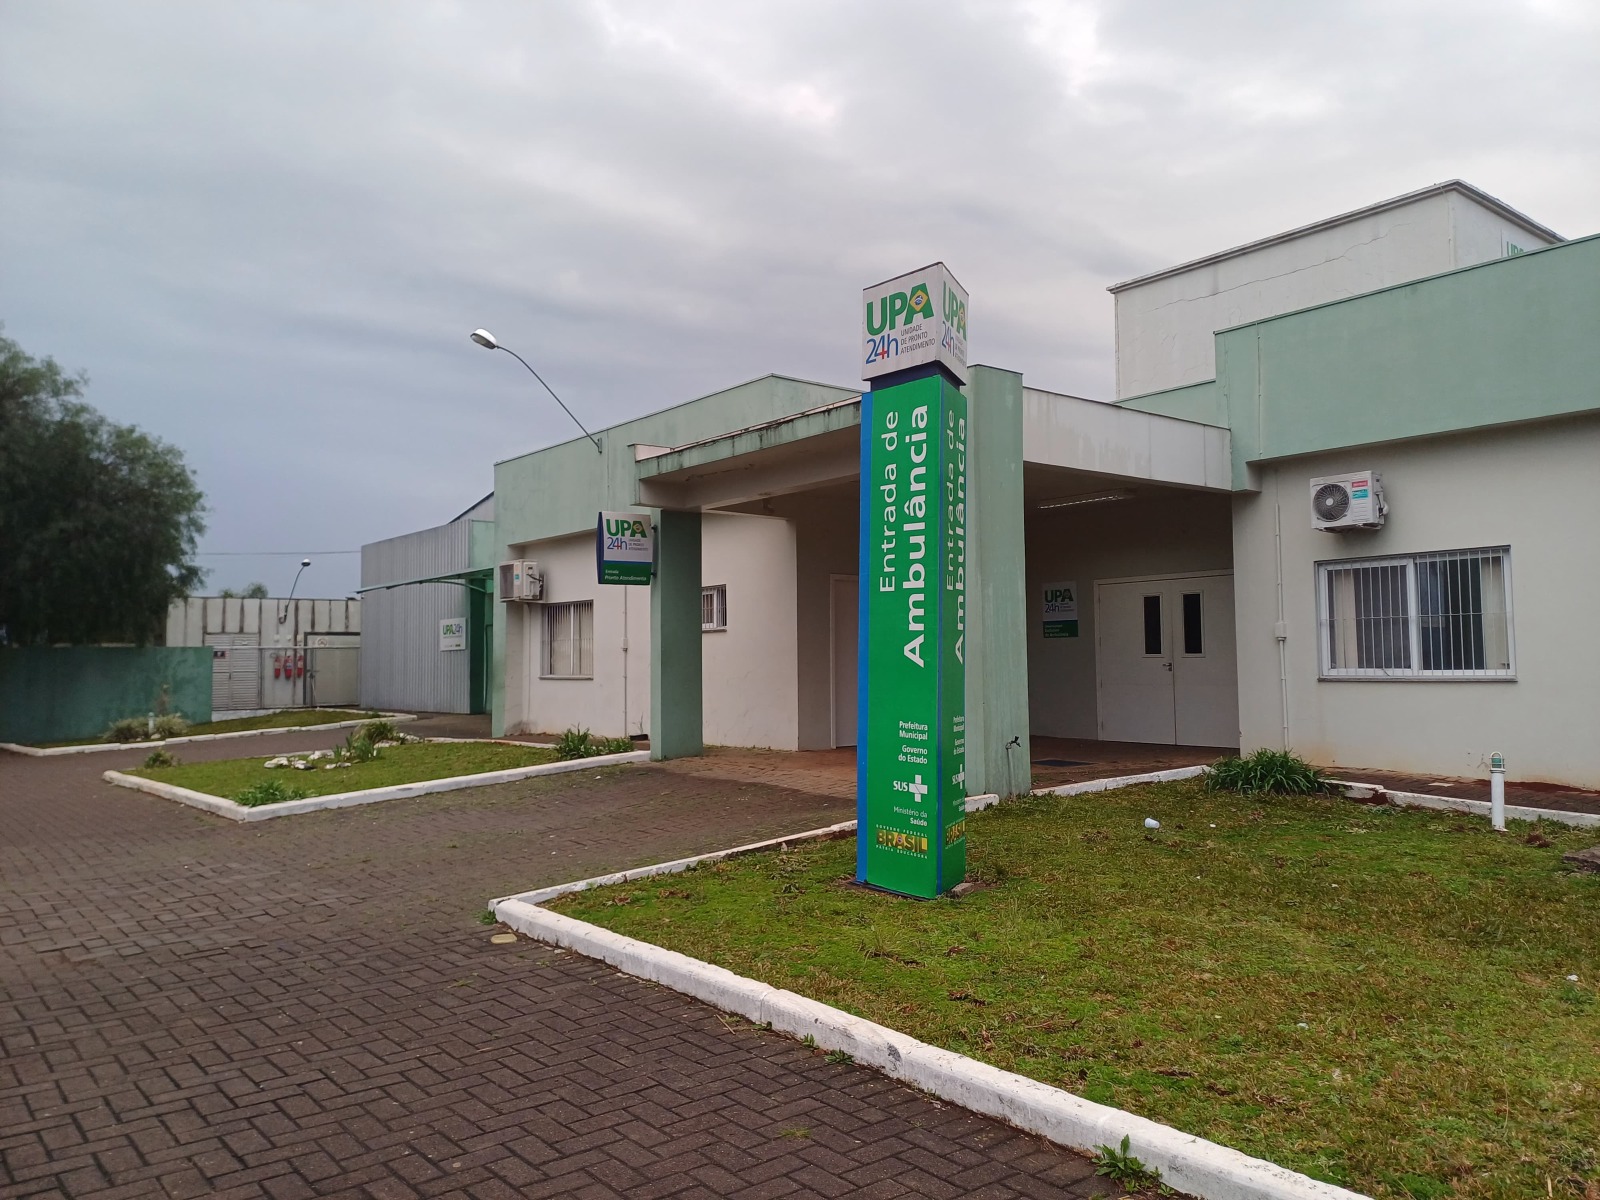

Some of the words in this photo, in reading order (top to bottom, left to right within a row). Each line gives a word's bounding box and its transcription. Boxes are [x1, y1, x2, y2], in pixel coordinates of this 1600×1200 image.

[866, 282, 935, 336] UPA
[943, 281, 967, 341] UPA
[900, 323, 923, 336] UNIDADE
[900, 337, 908, 345] DE
[908, 331, 928, 343] PRONTO
[900, 337, 936, 354] ATENDIMENTO
[941, 320, 955, 358] 24h
[865, 333, 899, 365] 24h
[881, 411, 899, 451] de
[946, 409, 955, 450] de
[606, 519, 647, 538] UPA
[880, 463, 897, 592] Entrada
[946, 463, 954, 591] Entrada
[606, 536, 628, 550] 24h
[902, 405, 928, 668] Ambulância
[955, 417, 965, 665] Ambulância
[1044, 589, 1074, 603] UPA
[899, 721, 928, 731] Prefeitura
[899, 730, 928, 741] Municipal
[898, 753, 906, 762] do
[907, 754, 928, 764] Estado
[901, 744, 928, 755] Governo
[893, 780, 908, 792] SUS
[893, 806, 919, 817] Ministério
[919, 811, 928, 819] da
[910, 817, 928, 827] Saúde
[876, 829, 928, 853] BRASIL
